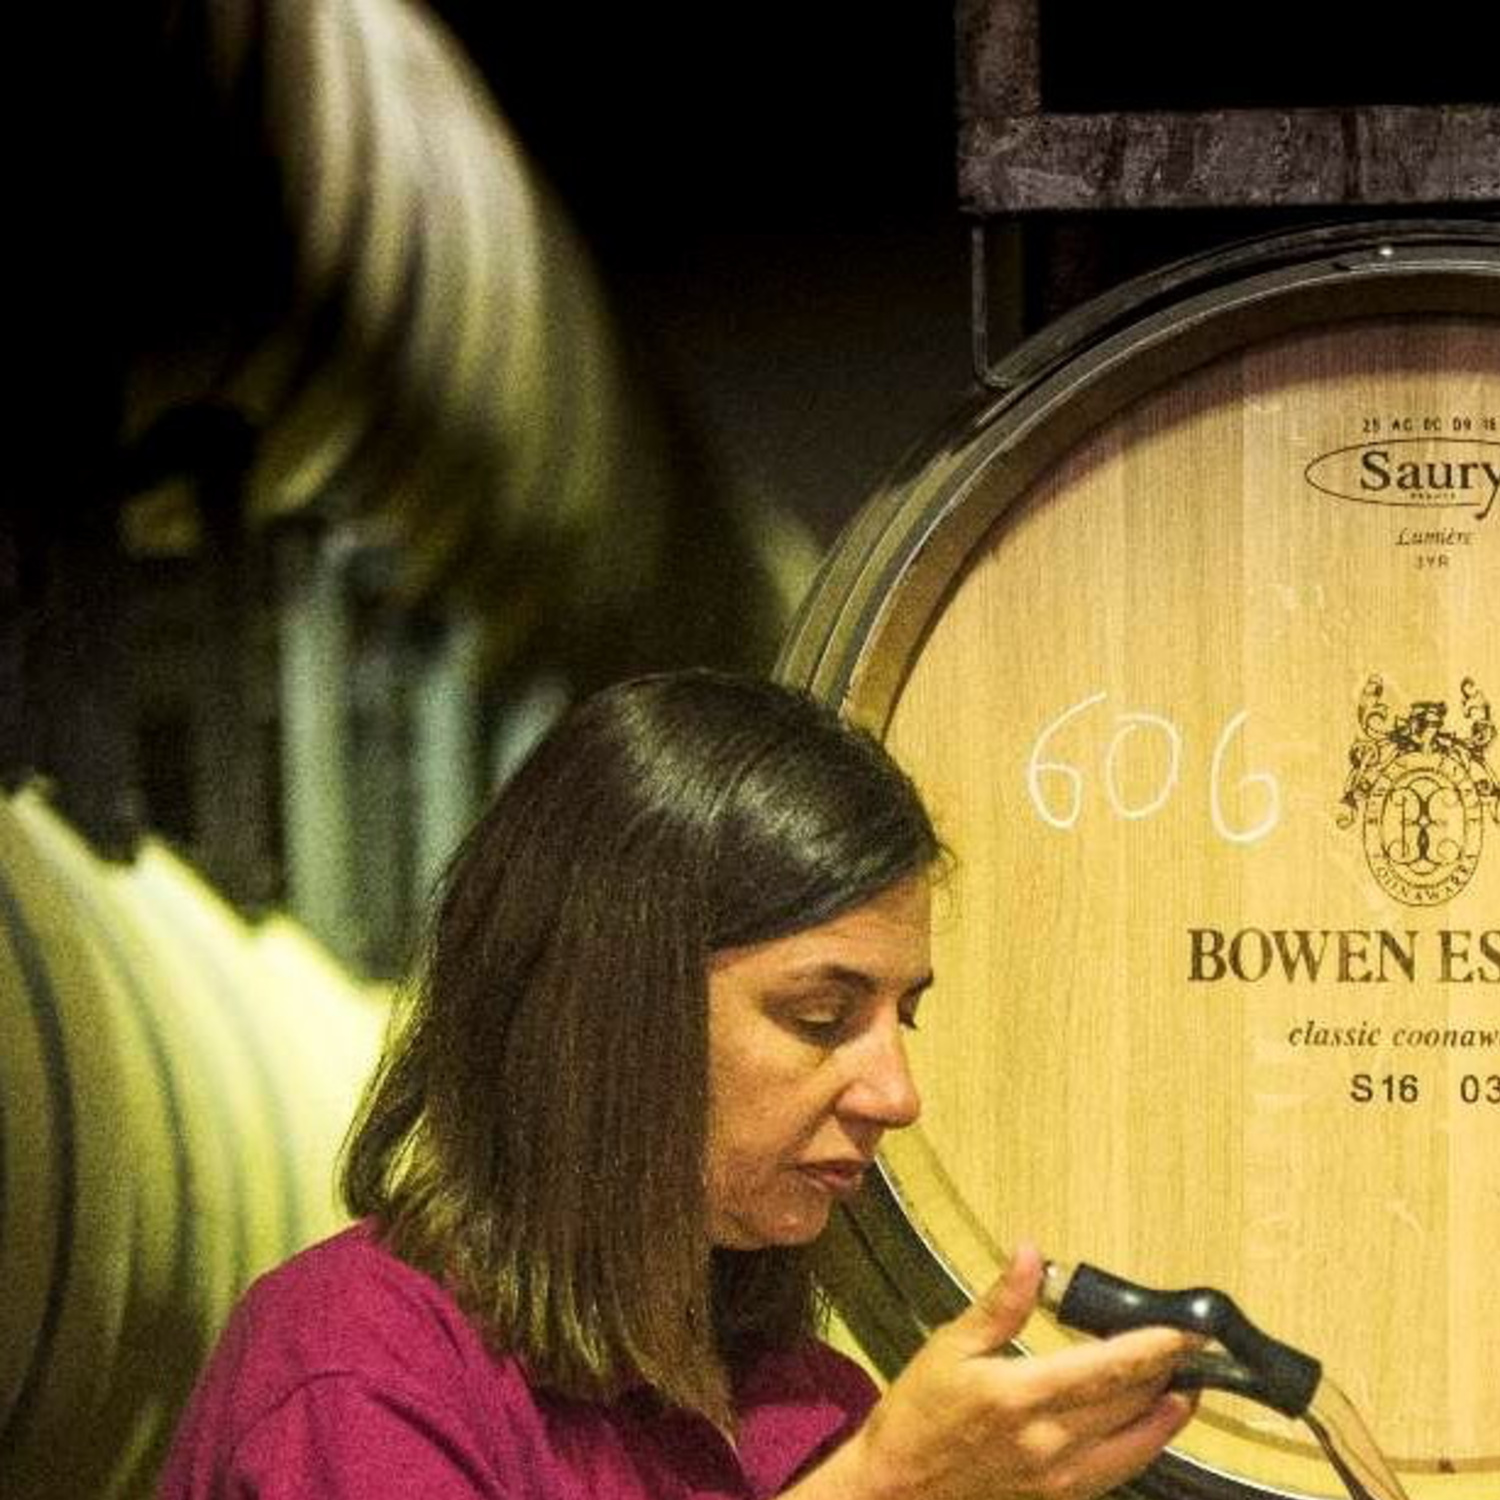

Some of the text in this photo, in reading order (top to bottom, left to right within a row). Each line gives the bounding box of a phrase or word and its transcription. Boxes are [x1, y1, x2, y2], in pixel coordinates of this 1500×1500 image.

[1028, 690, 1283, 843] 606
[1186, 927, 1419, 984] BOWEN
[1288, 1020, 1382, 1047] classic
[1350, 1072, 1419, 1103] S16
